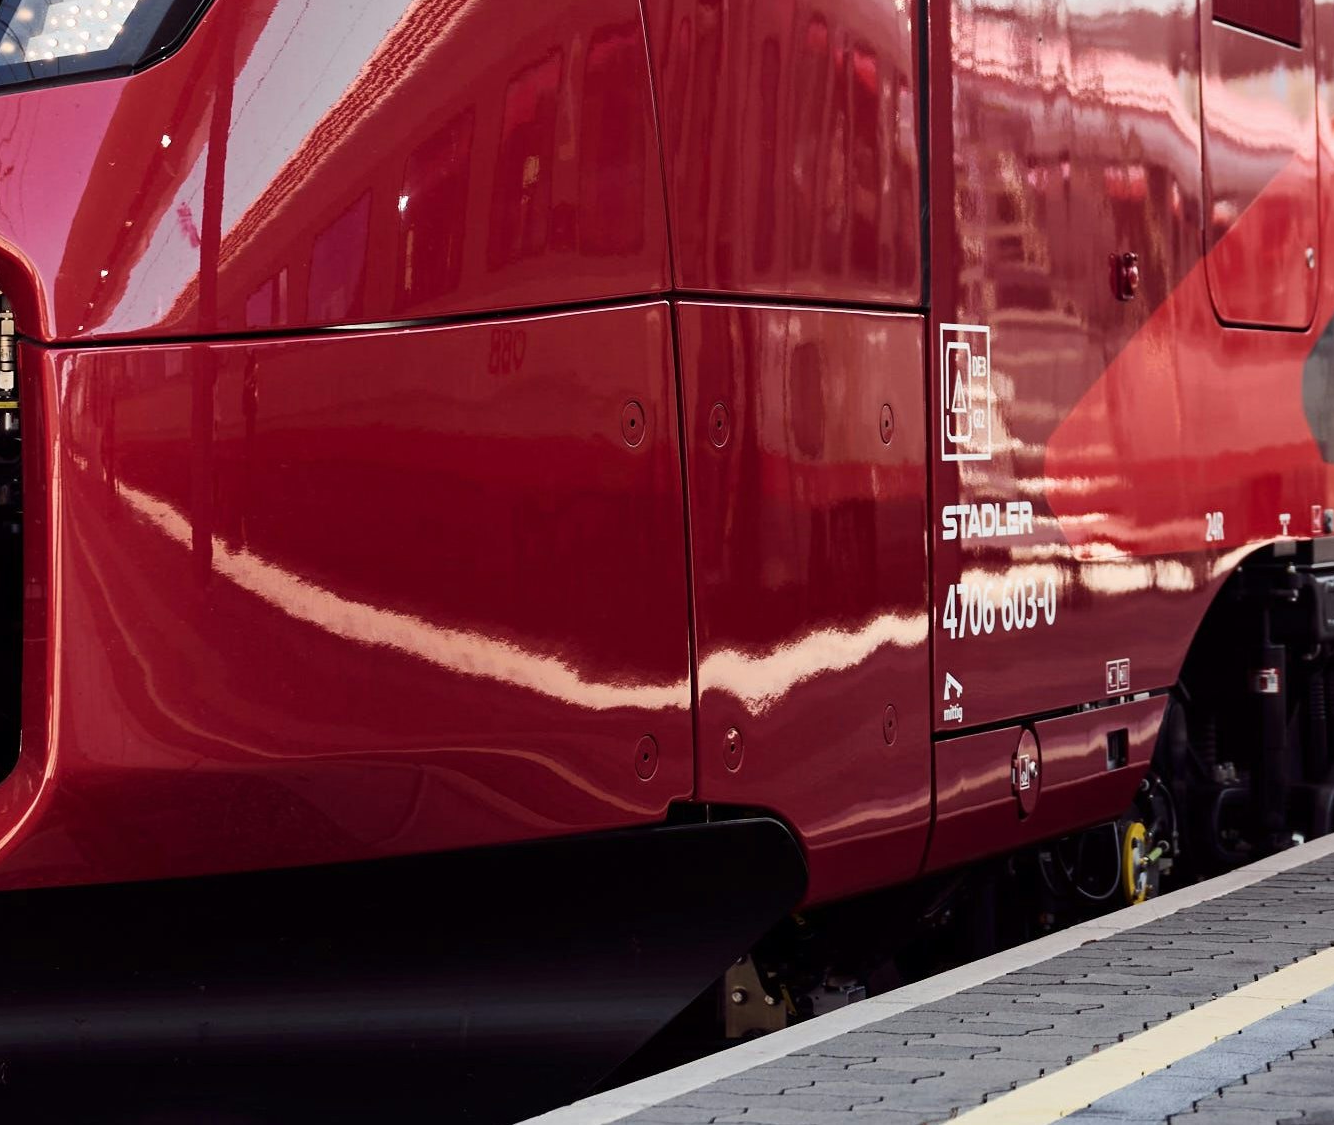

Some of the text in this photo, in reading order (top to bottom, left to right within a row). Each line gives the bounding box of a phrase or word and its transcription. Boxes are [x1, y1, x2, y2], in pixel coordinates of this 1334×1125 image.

[942, 501, 1033, 540] STADLER
[943, 575, 1056, 639] 4706 603-0
